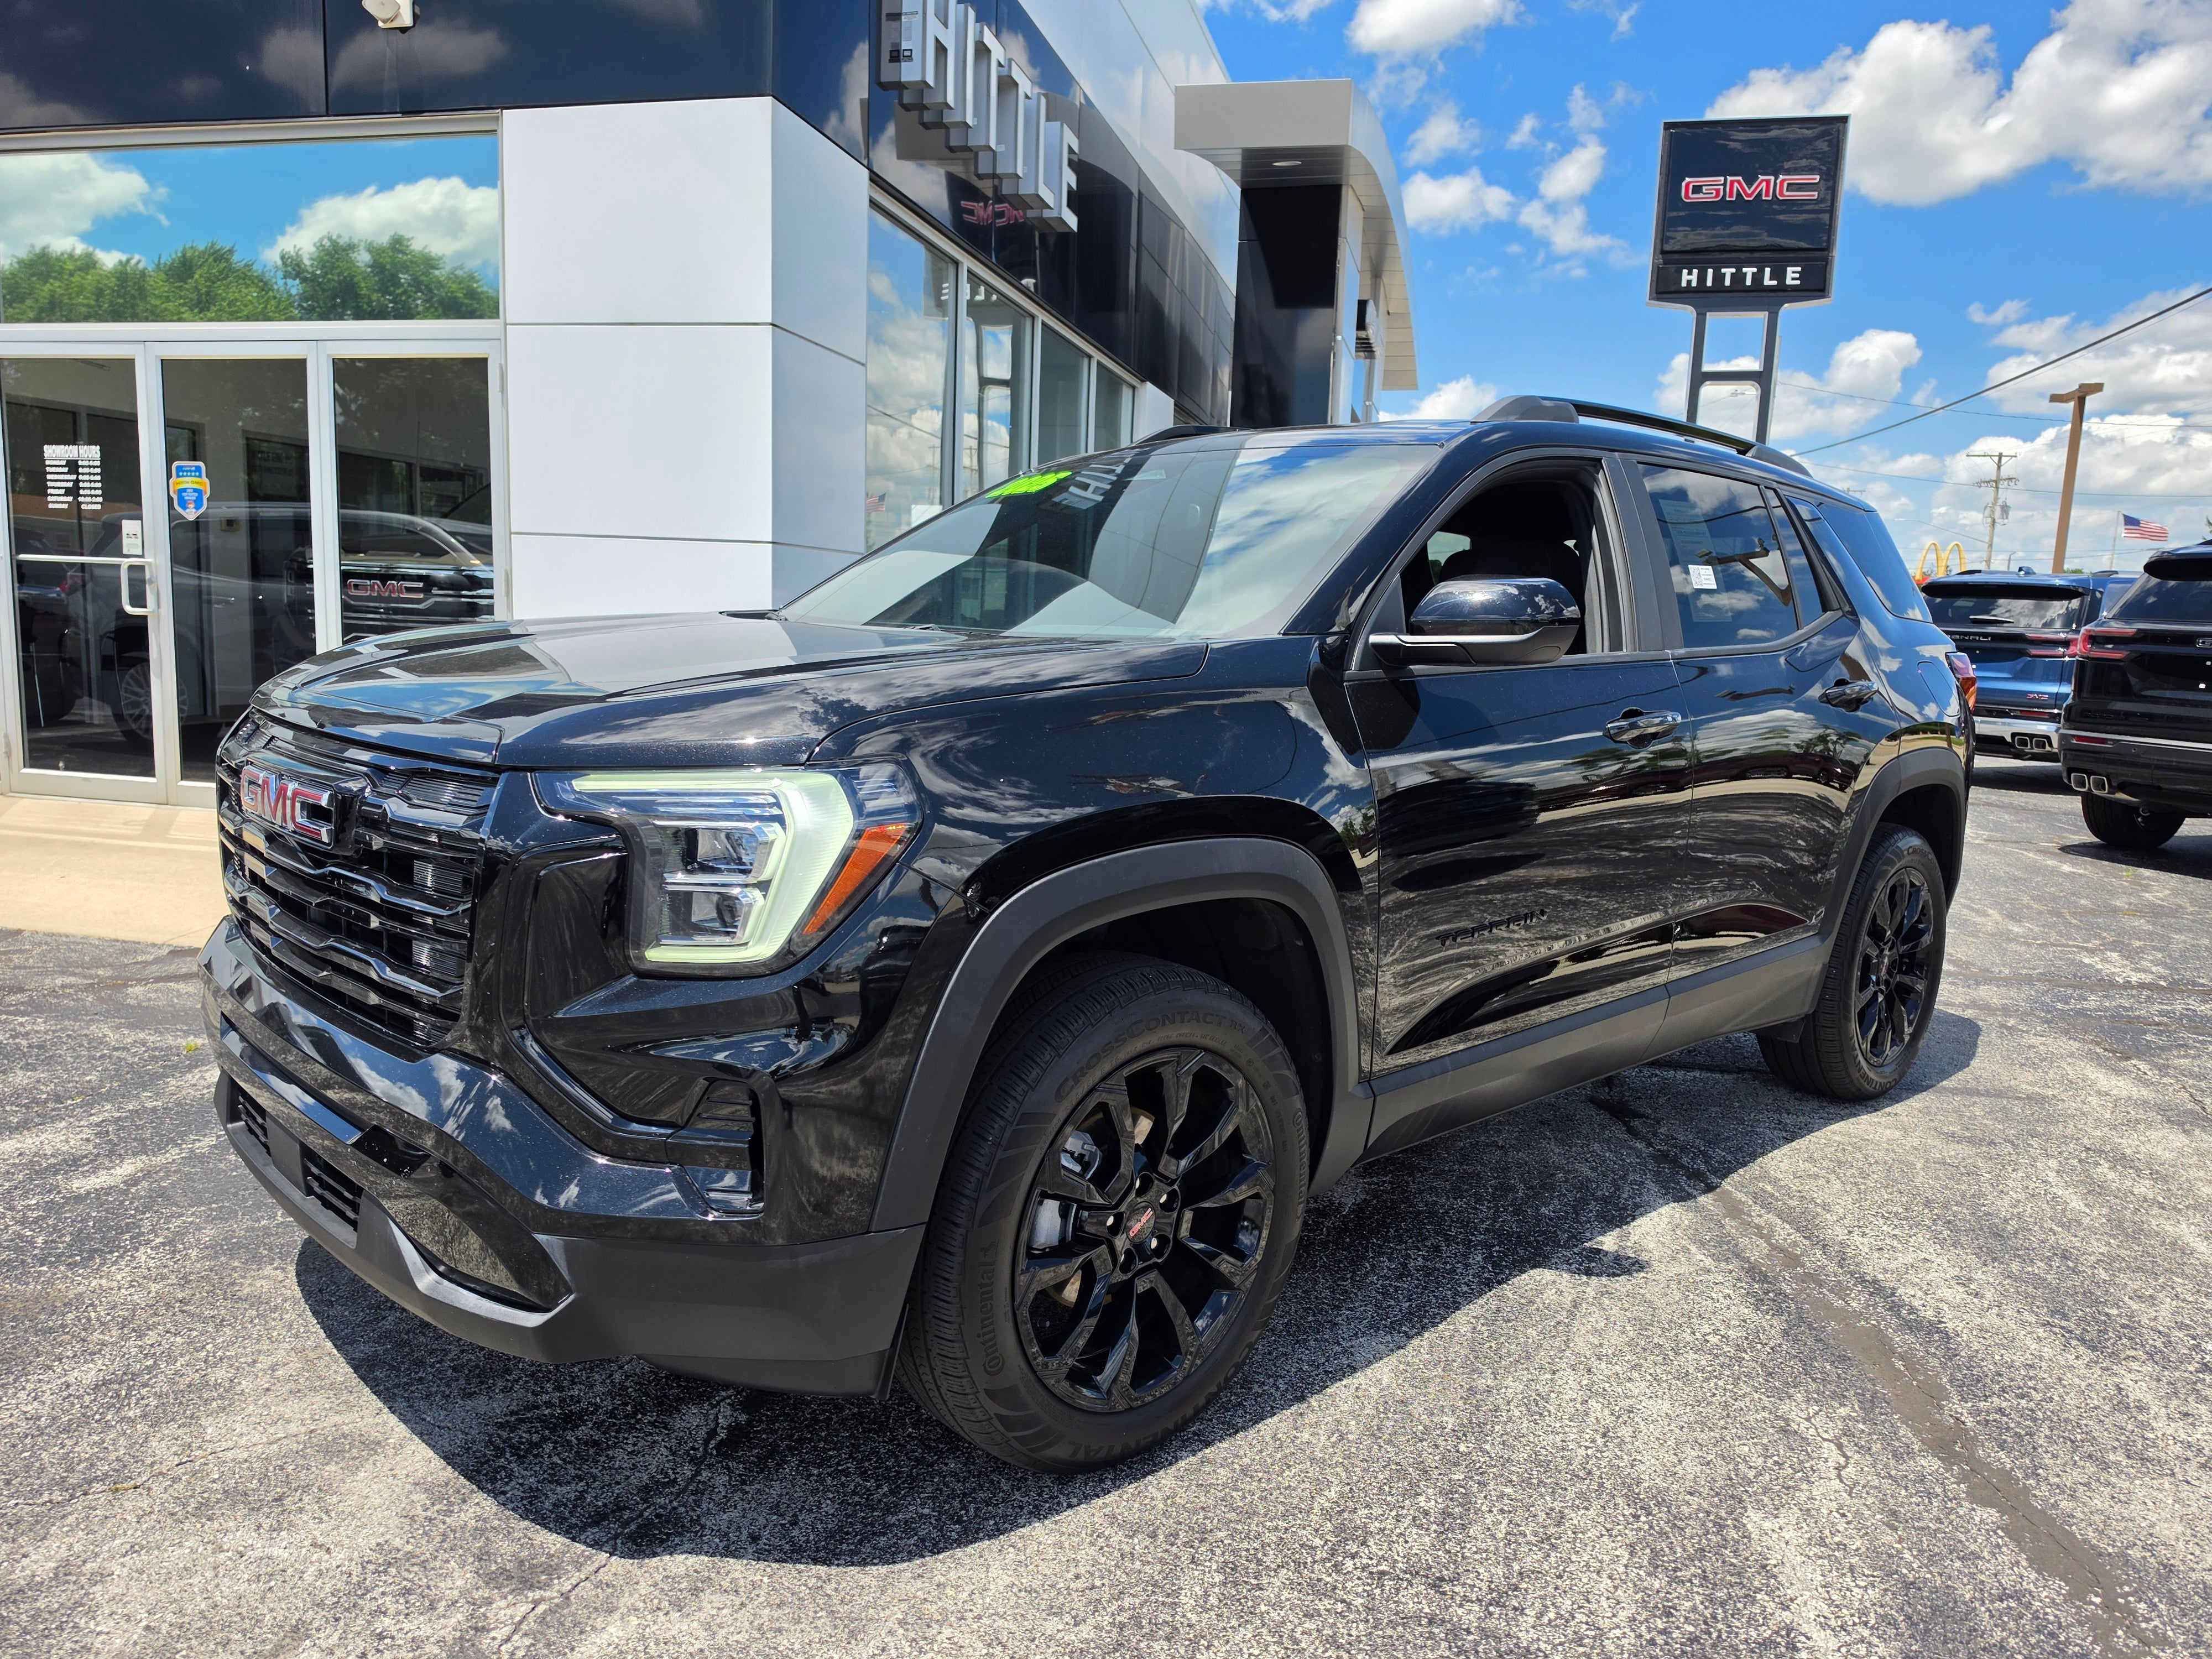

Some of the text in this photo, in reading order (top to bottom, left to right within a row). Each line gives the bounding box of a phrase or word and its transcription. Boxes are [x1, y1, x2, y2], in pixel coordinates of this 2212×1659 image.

[901, 0, 1078, 233] HITTLE
[1681, 174, 1820, 202] GMC
[1681, 267, 1802, 287] HITTLE
[44, 445, 101, 458] SHOWROOM HOURS
[347, 579, 424, 598] GMC
[239, 764, 335, 844] GMC
[1129, 1207, 1154, 1237] GMC
